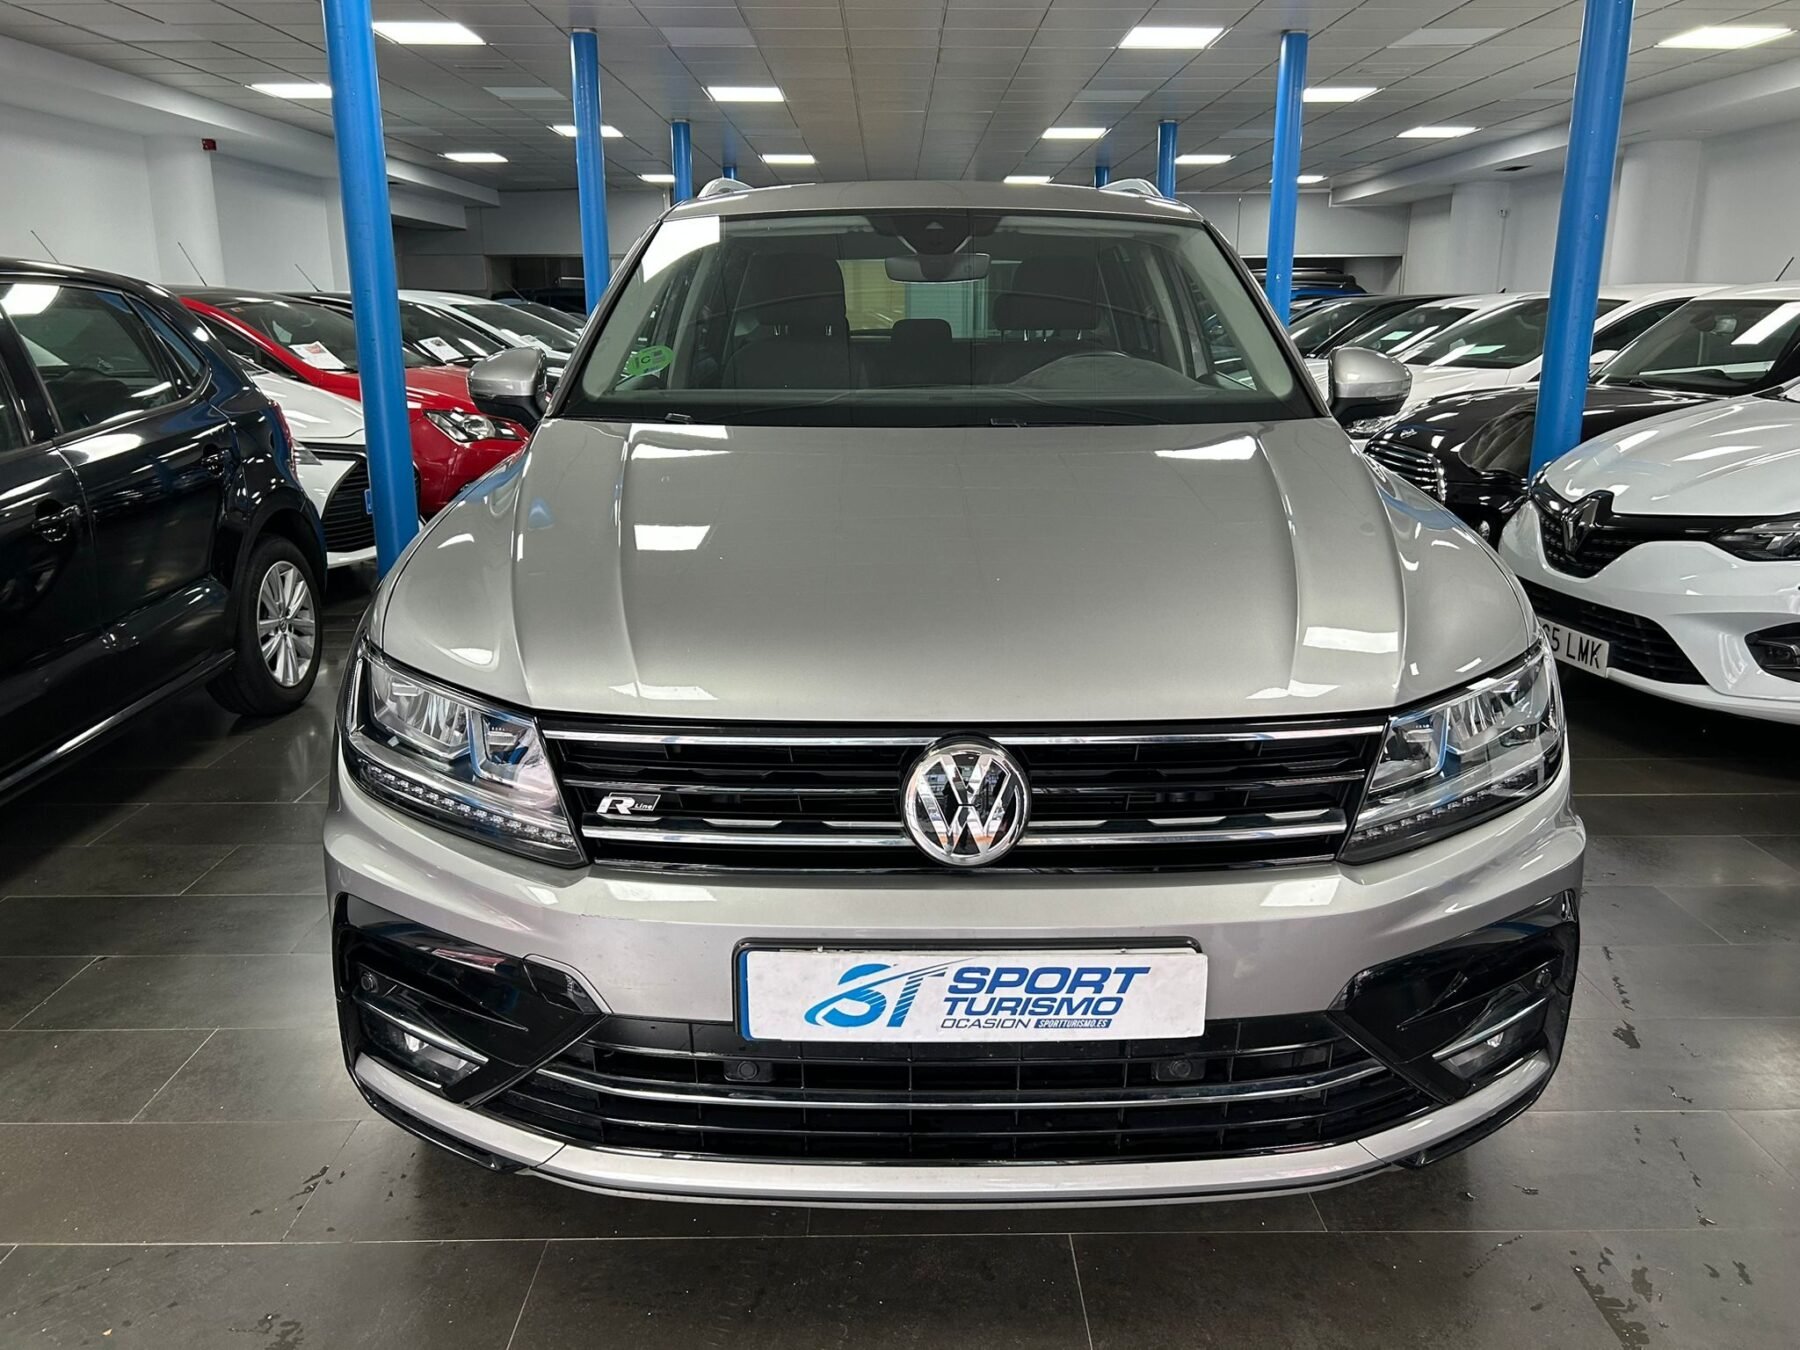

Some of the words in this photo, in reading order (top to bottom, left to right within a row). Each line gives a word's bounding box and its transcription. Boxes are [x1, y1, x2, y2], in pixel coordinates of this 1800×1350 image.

[1566, 632, 1602, 669] LMK
[947, 966, 1152, 995] SPORT
[943, 996, 1124, 1017] TURISMO
[940, 1017, 1032, 1029] OCASION
[1037, 1018, 1109, 1029] SPORTTURISMO.ES
